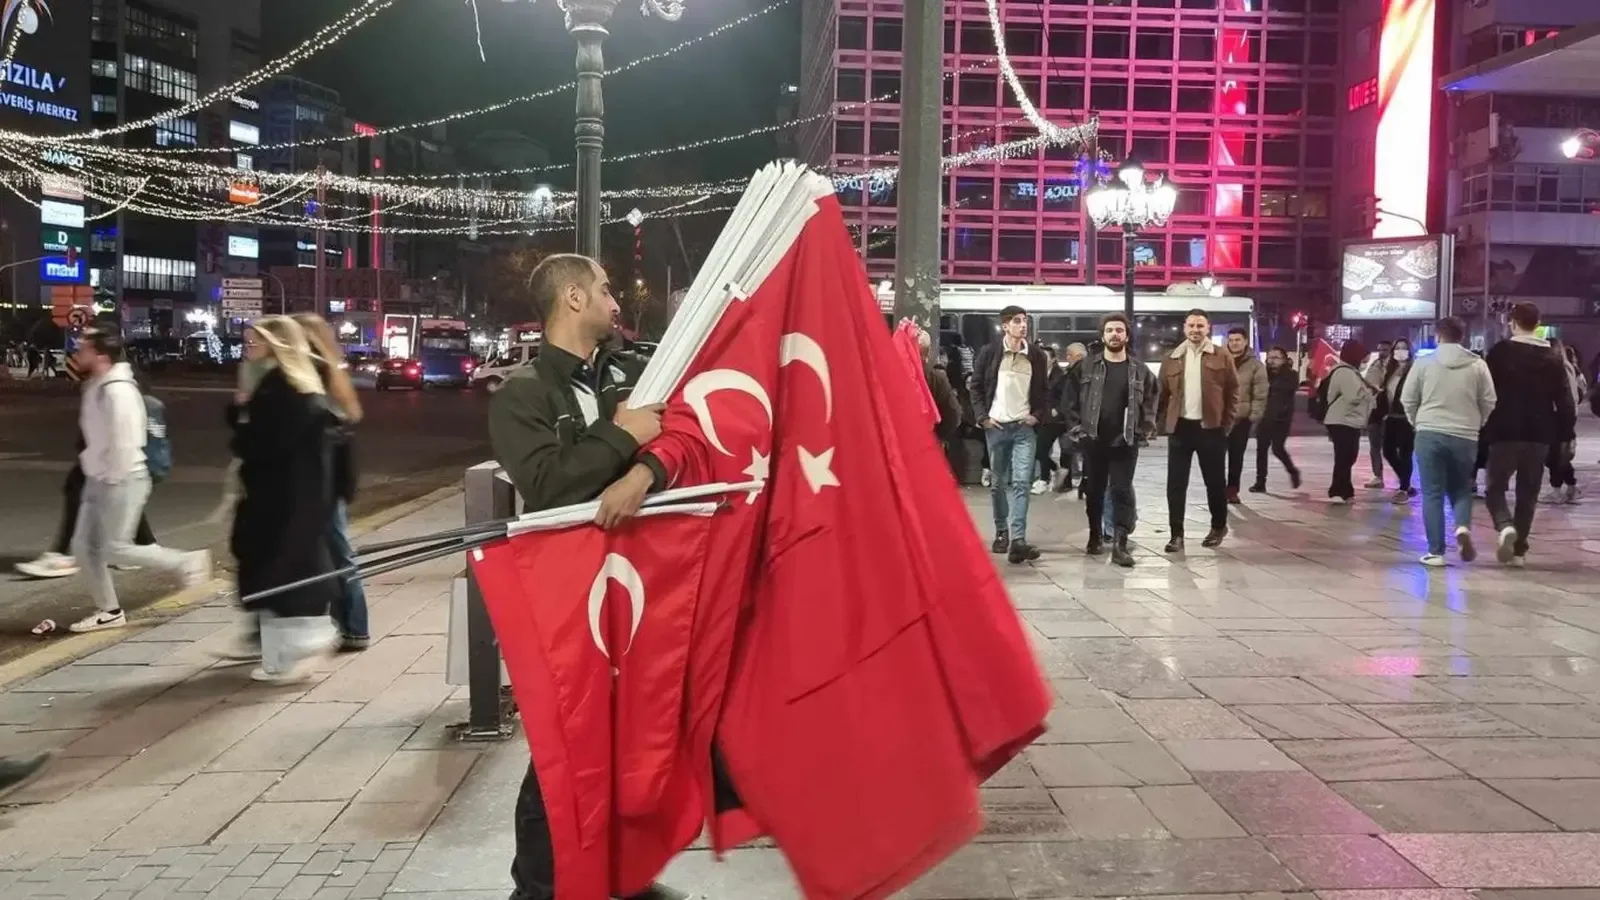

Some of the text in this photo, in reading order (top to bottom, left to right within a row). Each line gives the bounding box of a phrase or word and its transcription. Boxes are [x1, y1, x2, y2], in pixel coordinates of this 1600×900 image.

[36, 101, 78, 122] MERKEZ
[42, 148, 84, 168] MANGO
[58, 231, 68, 245] D
[46, 262, 79, 278] mavi
